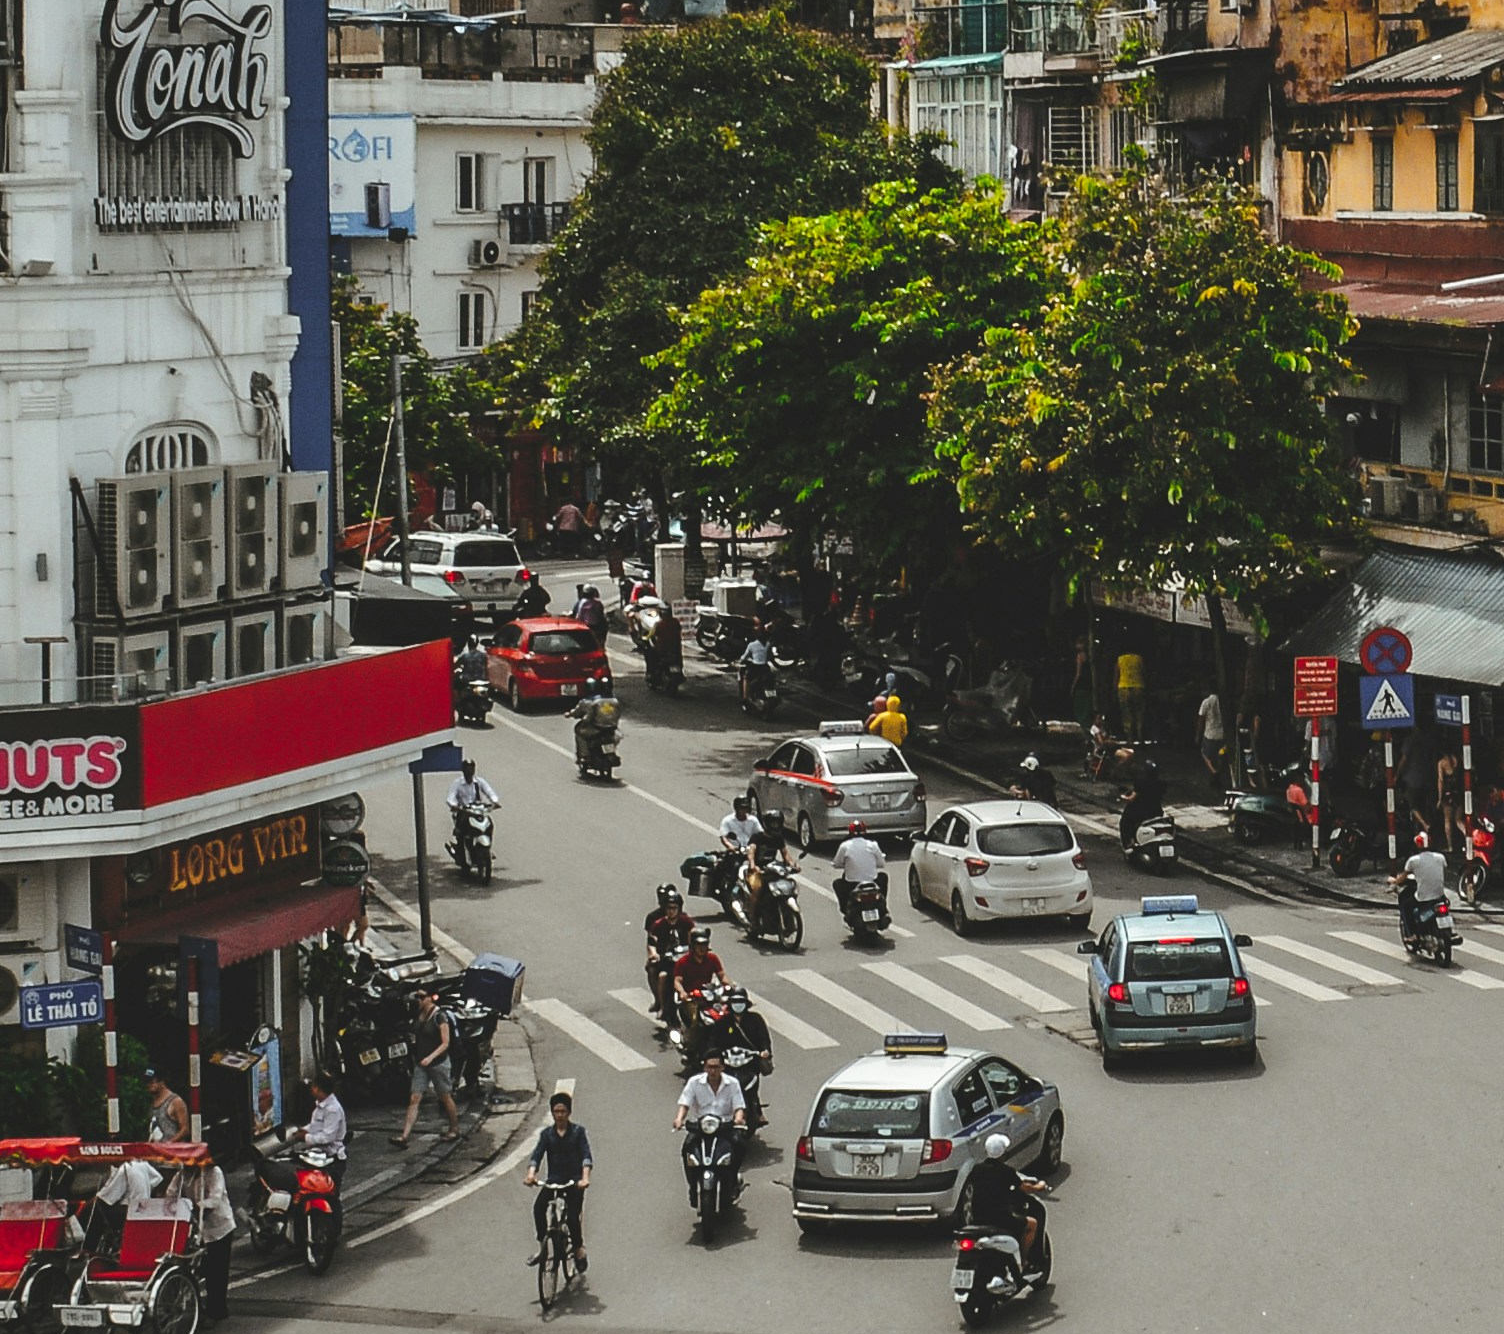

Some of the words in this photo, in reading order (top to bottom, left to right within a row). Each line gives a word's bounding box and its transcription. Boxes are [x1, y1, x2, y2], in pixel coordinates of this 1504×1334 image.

[97, 195, 117, 224] The
[119, 196, 143, 225] best
[144, 197, 213, 226] entertainment
[214, 199, 241, 227] show
[169, 832, 245, 892] LONG
[27, 1003, 44, 1023] LÊ
[47, 1000, 77, 1021] THÁI
